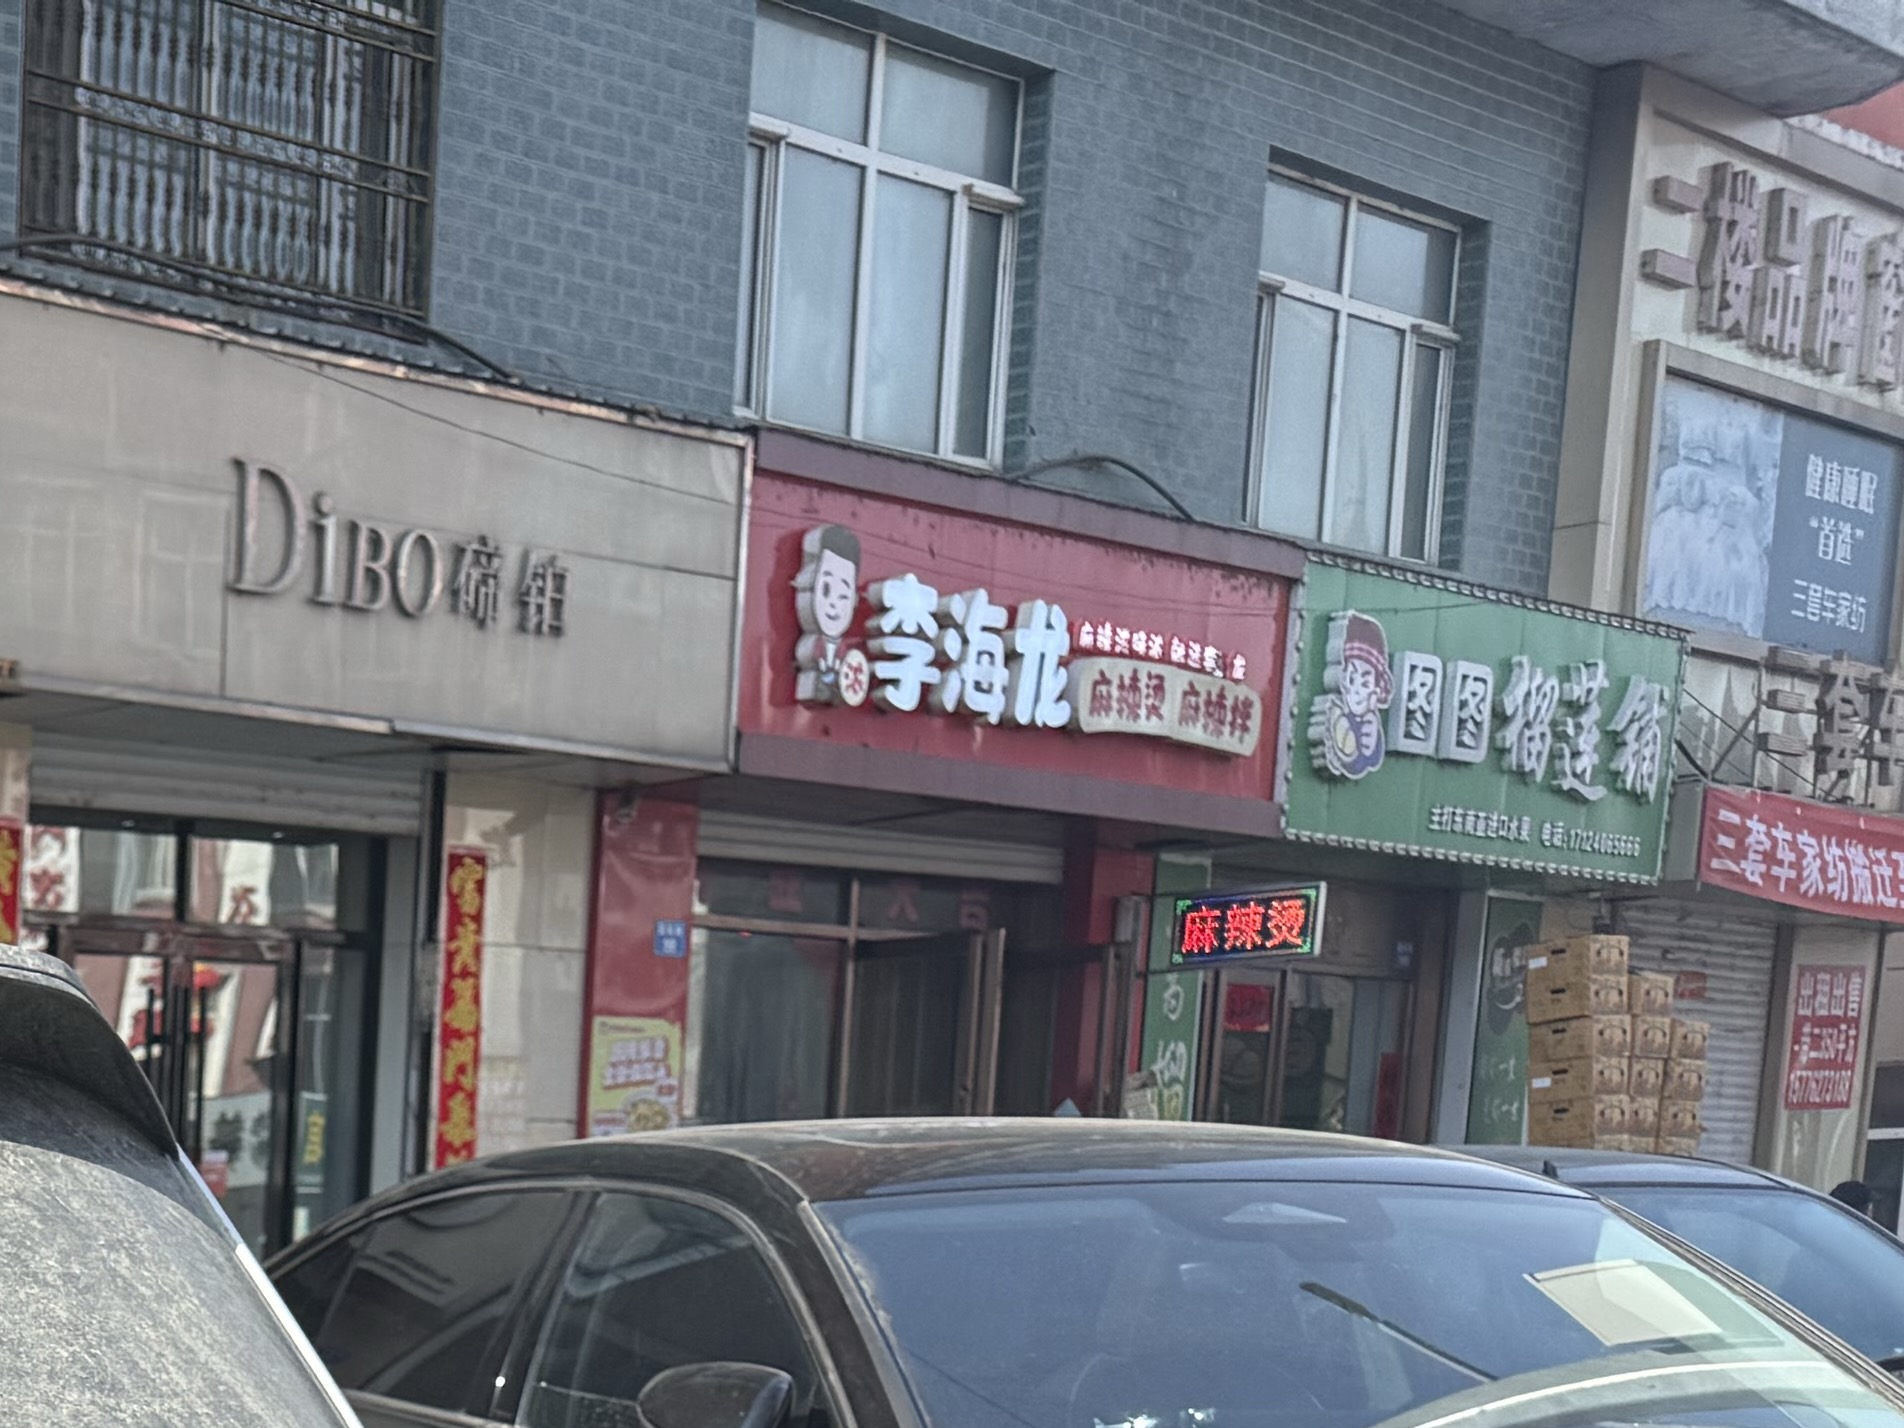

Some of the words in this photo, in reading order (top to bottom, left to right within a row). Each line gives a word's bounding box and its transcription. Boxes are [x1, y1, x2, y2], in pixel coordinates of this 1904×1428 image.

[874, 573, 1071, 728] 李海龙
[1089, 668, 1167, 723] 麻辣烫
[1178, 681, 1255, 744] 麻辣拌
[1181, 899, 1306, 953] 麻辣烫
